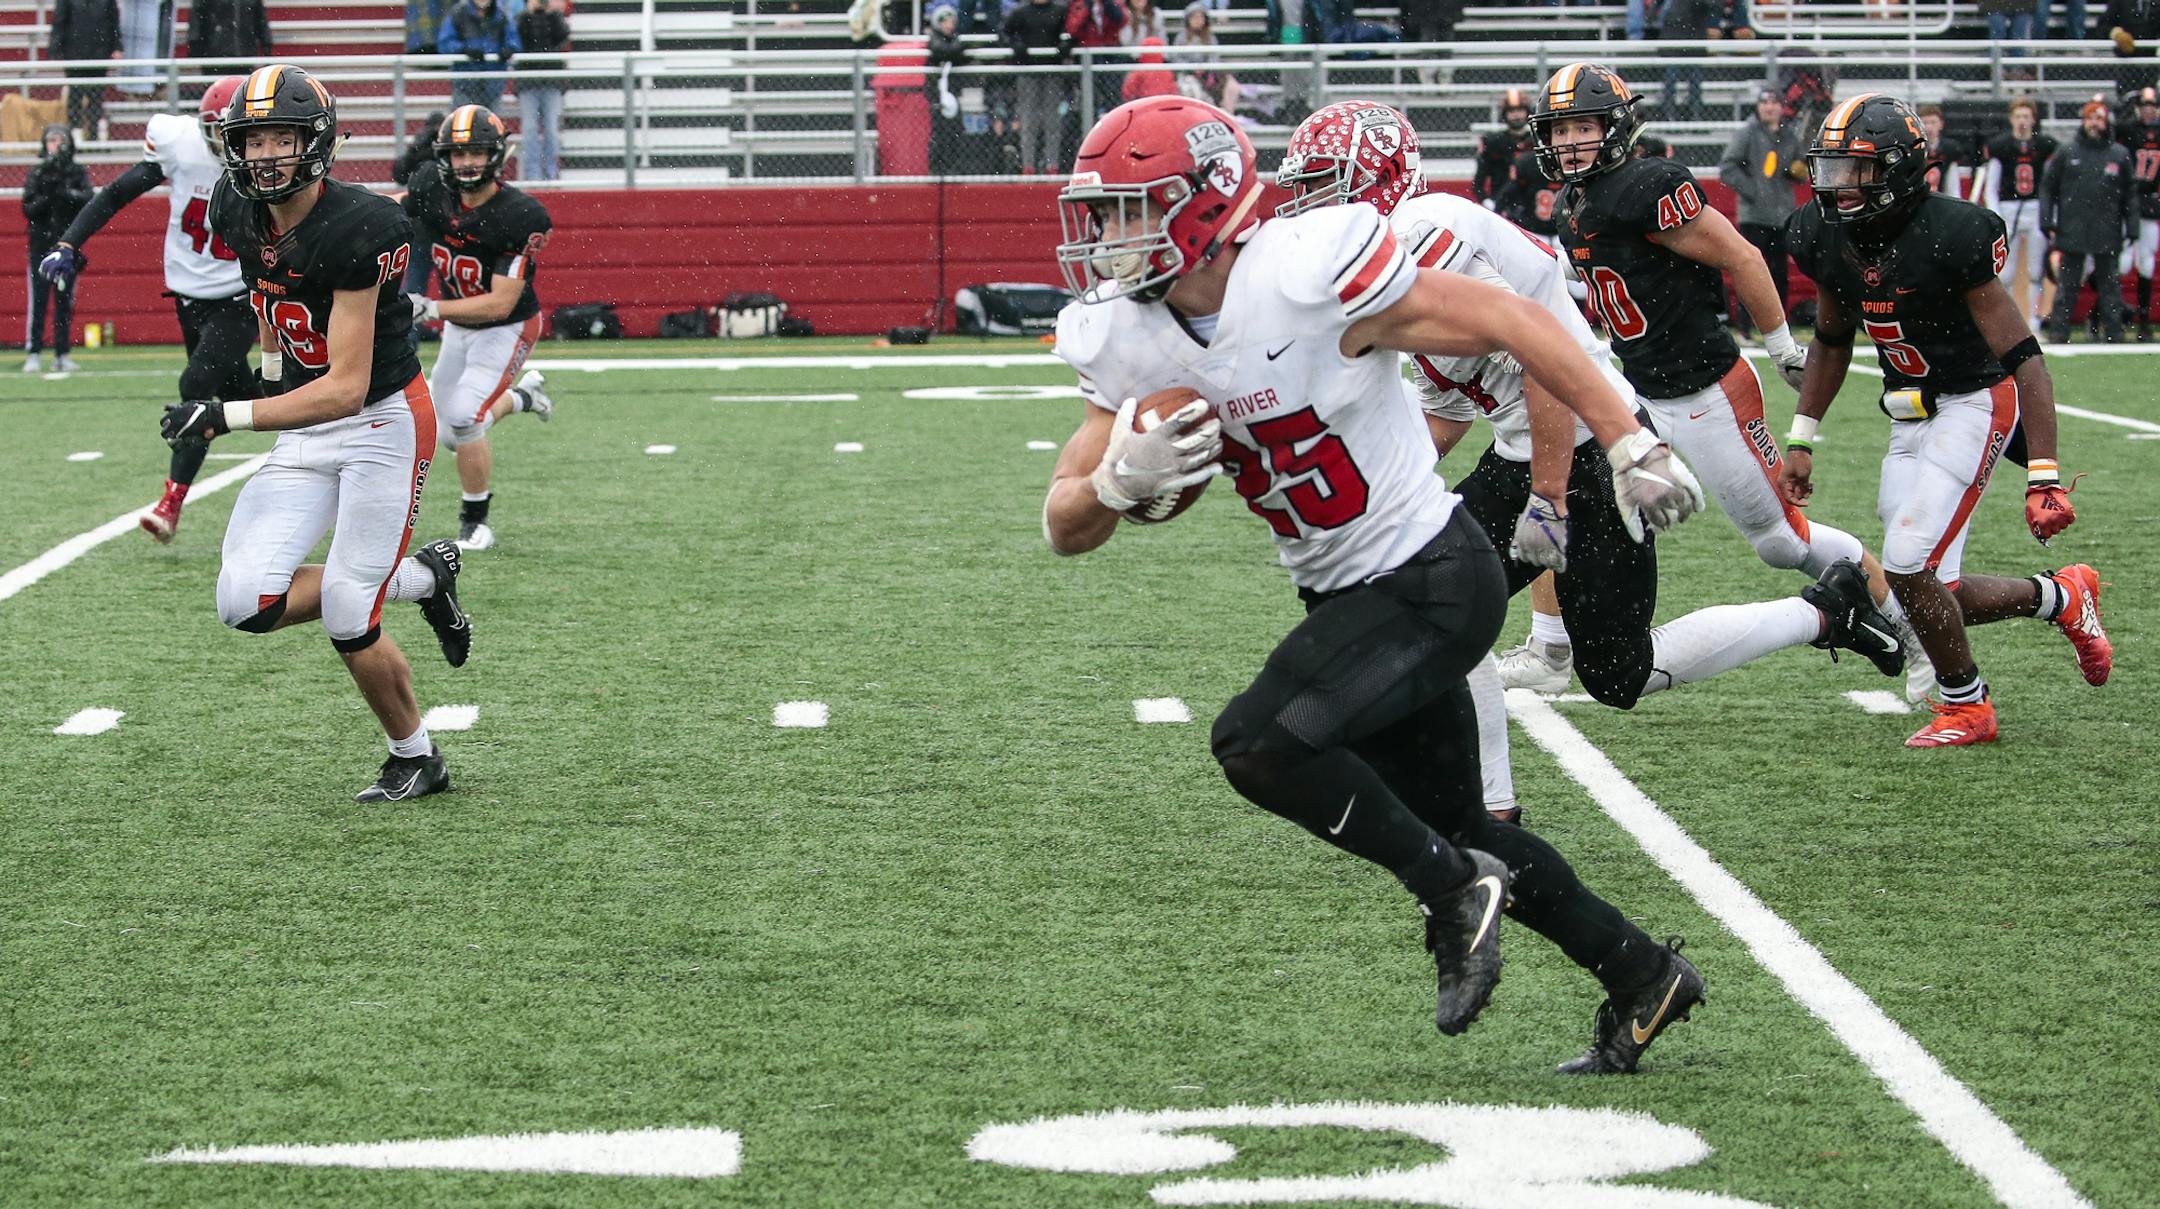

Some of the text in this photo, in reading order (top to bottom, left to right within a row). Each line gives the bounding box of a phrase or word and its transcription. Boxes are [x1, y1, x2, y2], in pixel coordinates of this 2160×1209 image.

[1190, 123, 1227, 145] 128
[1658, 181, 1702, 231] 40
[377, 242, 411, 289] 19
[1991, 233, 2009, 276] 5
[256, 277, 288, 296] SPUDS
[1861, 301, 1895, 315] SPUDS
[1862, 318, 1931, 378] 5
[1226, 387, 1281, 420] RIVER
[1745, 416, 1780, 469] SPUDS
[407, 458, 432, 530] SPUDS
[1218, 403, 1371, 541] 25
